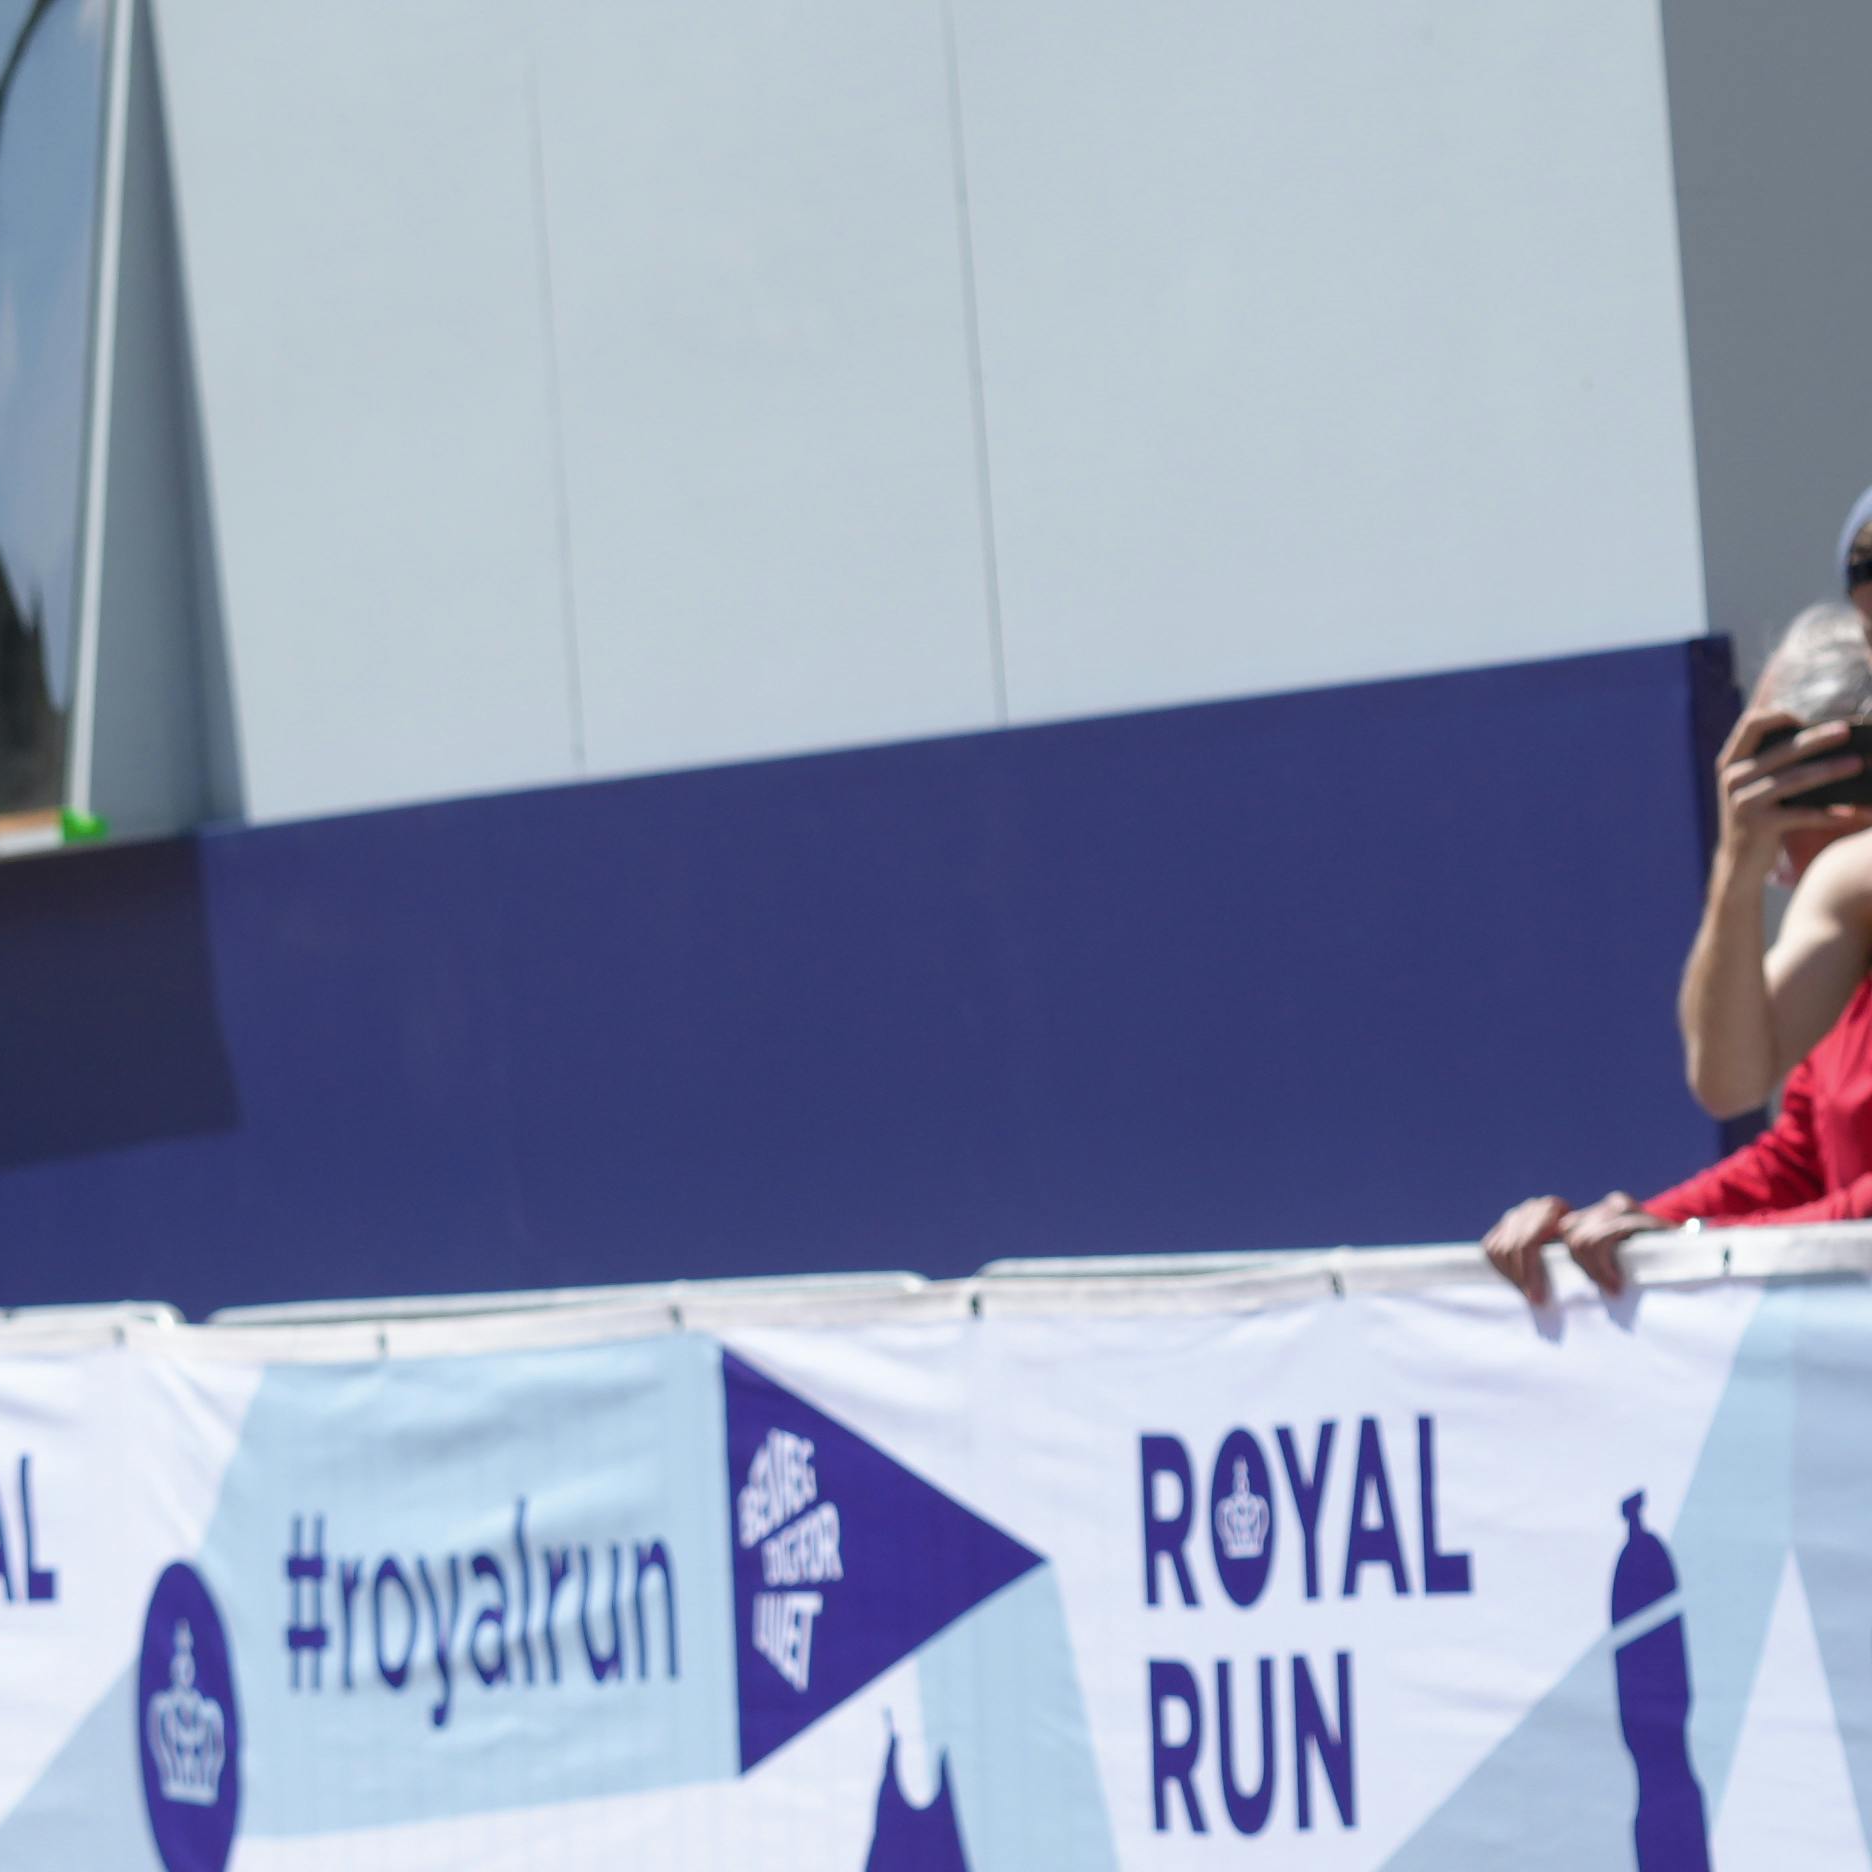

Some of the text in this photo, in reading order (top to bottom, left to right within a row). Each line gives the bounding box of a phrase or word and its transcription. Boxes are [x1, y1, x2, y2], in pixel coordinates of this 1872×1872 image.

[1138, 1414, 1473, 1609] ROYAL
[284, 1496, 681, 1730] #royalrun
[1146, 1648, 1360, 1837] RUN
